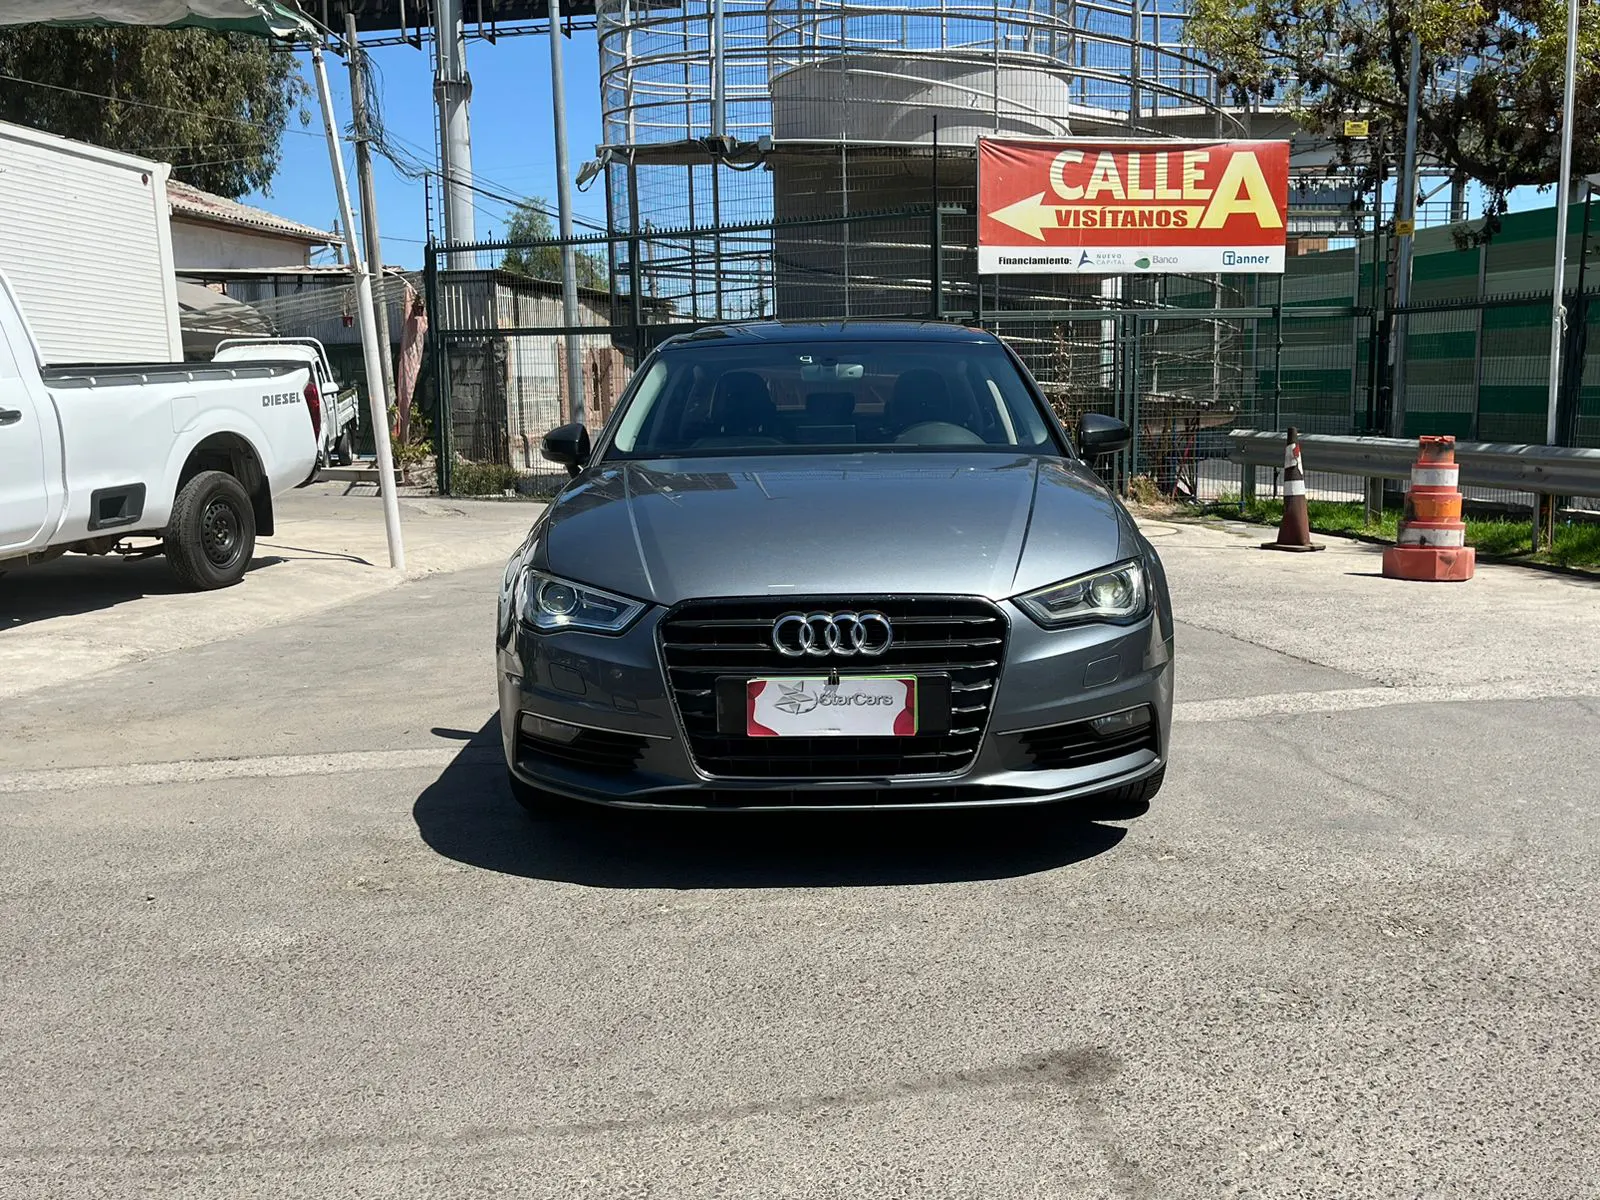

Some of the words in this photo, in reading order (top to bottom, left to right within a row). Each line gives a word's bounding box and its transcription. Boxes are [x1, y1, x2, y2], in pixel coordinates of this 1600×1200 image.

[1049, 150, 1213, 200] CALLE
[1200, 151, 1283, 229] A
[1055, 207, 1188, 228] VISÍTANOS
[998, 256, 1072, 265] Financiamiento:
[1152, 255, 1179, 264] Banco
[1222, 251, 1270, 265] Tanner
[262, 392, 301, 407] DIESEL
[820, 692, 894, 706] StarCars
